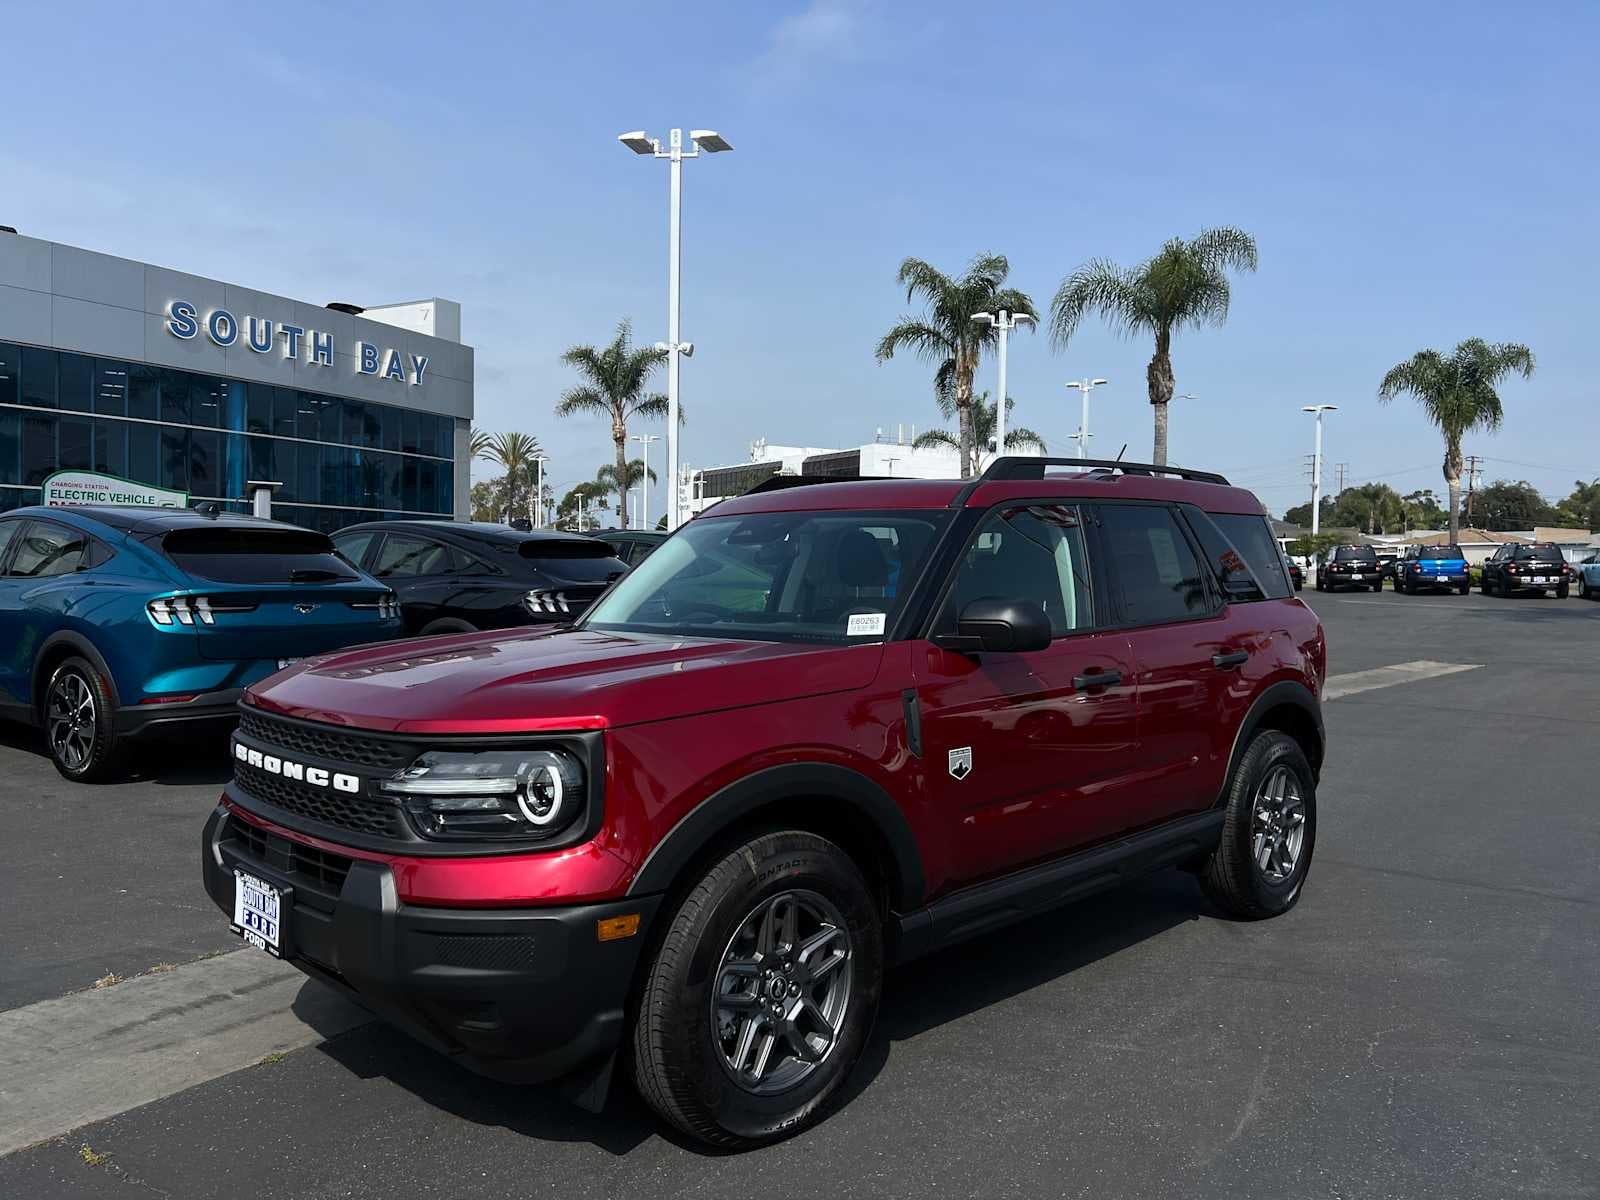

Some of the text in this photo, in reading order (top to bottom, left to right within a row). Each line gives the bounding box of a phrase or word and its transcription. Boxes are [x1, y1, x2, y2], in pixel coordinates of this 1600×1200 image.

[167, 301, 430, 385] SOUTH BAY
[50, 489, 155, 505] ELECTRIC VEHICLE
[235, 743, 360, 794] BRONCO
[244, 909, 275, 938] FORD
[243, 929, 265, 950] FORD
